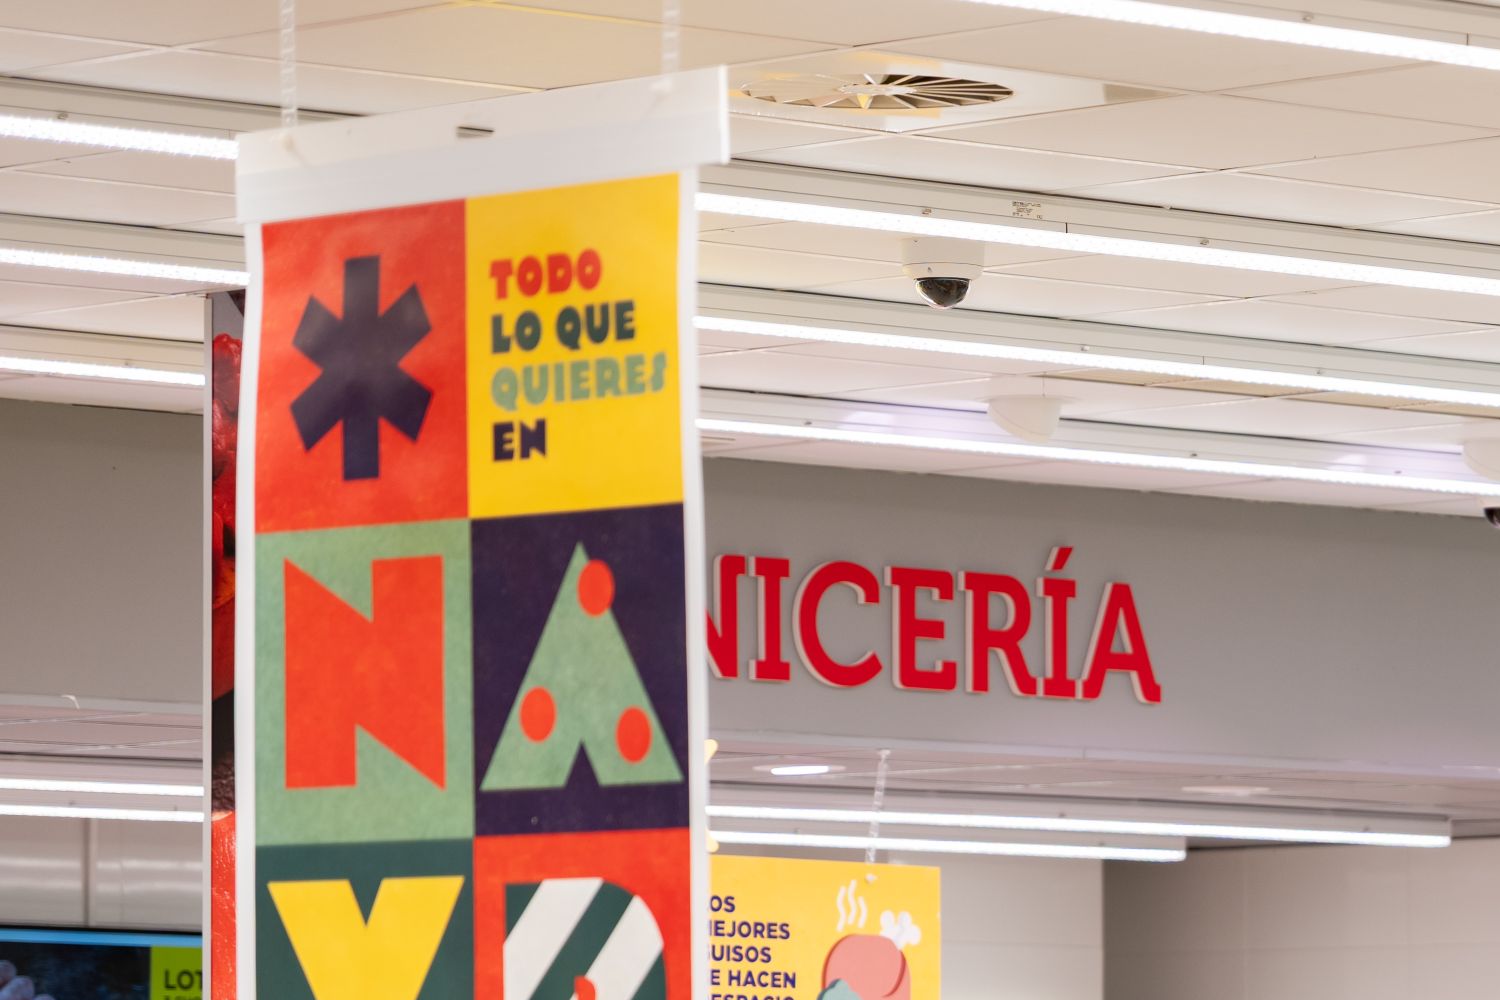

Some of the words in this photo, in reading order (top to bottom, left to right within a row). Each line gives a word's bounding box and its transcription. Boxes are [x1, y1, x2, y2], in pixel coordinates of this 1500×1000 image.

[490, 248, 602, 300] TODO
[491, 311, 542, 355] LO
[556, 300, 636, 350] QUE
[491, 352, 668, 412] QUIERES
[492, 417, 547, 463] EN
[709, 919, 791, 940] EJORES
[709, 944, 772, 964] UISOS
[728, 969, 797, 989] HACEN
